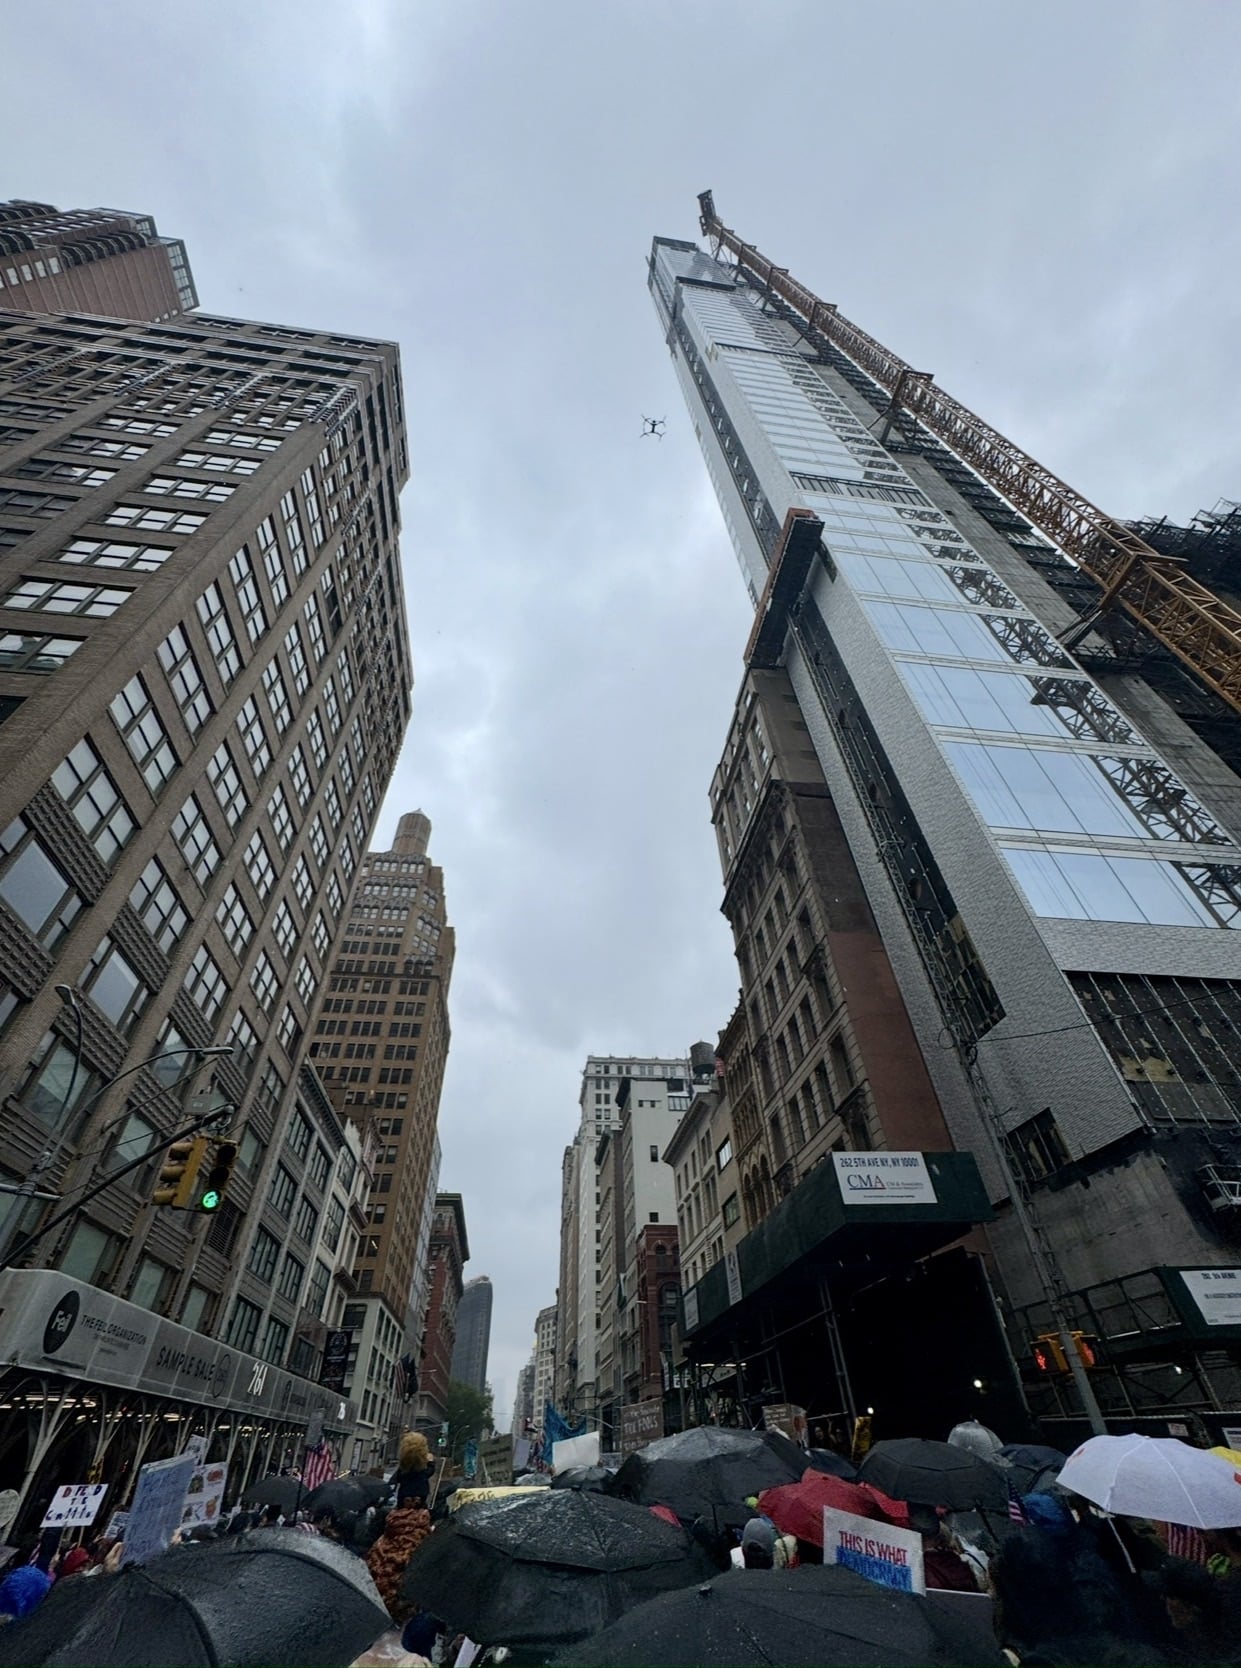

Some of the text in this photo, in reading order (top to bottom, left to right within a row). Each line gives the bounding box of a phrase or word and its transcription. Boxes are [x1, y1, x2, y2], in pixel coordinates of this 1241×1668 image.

[839, 1157, 853, 1168] 262
[853, 1157, 866, 1168] 5TH
[867, 1157, 880, 1167] AVE
[891, 1157, 901, 1167] NY
[901, 1157, 920, 1167] 10001
[847, 1174, 886, 1188] CMA
[80, 1315, 96, 1329] THE
[107, 1323, 148, 1345] ORGANIZATION
[156, 1346, 196, 1376] SAMPLE
[194, 1359, 216, 1381] SALE
[247, 1360, 269, 1397] 261
[62, 1485, 103, 1498] DFED
[839, 1530, 908, 1567] THIS IS WHAT
